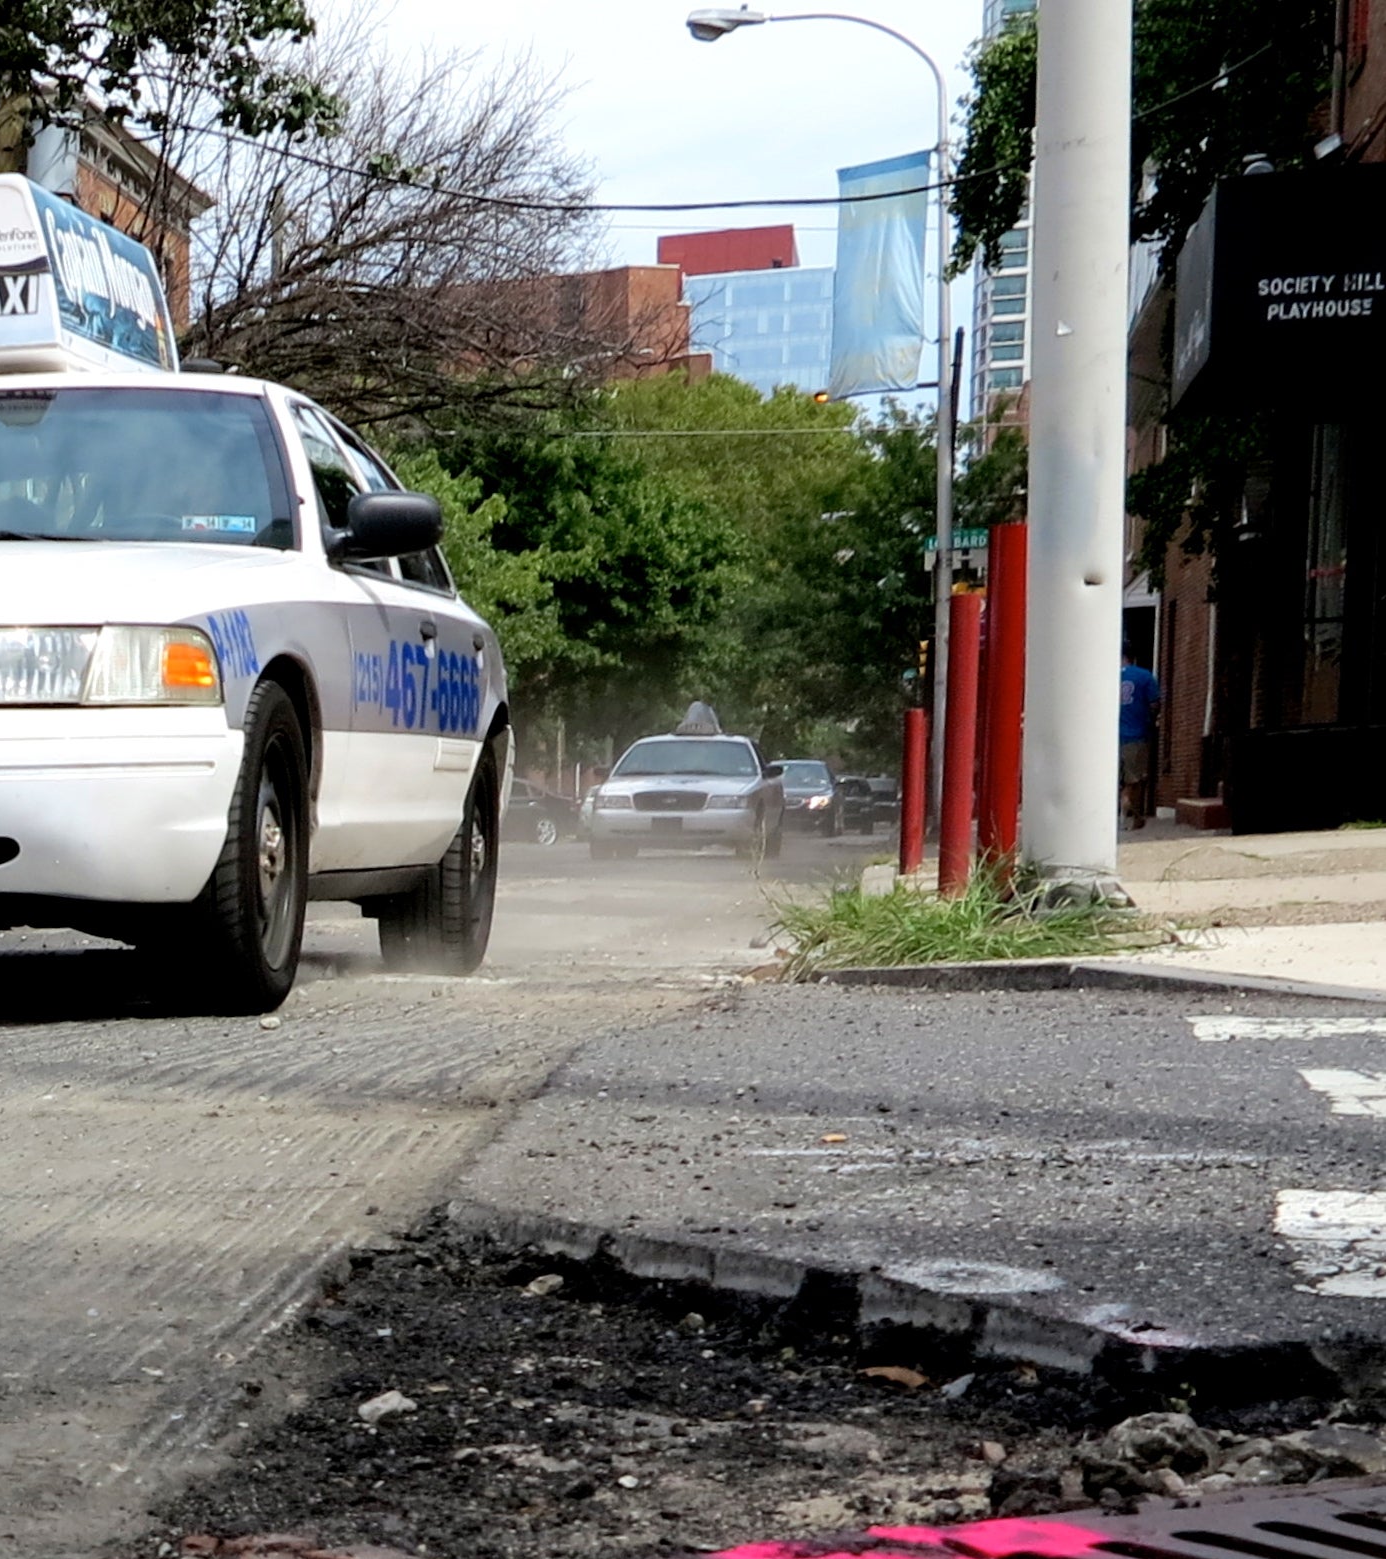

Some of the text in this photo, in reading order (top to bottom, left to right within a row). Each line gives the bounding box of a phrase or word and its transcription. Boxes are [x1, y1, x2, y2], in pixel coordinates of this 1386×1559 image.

[1258, 272, 1385, 296] SOCIETY HILL
[1267, 298, 1373, 321] PLAYHOUSE
